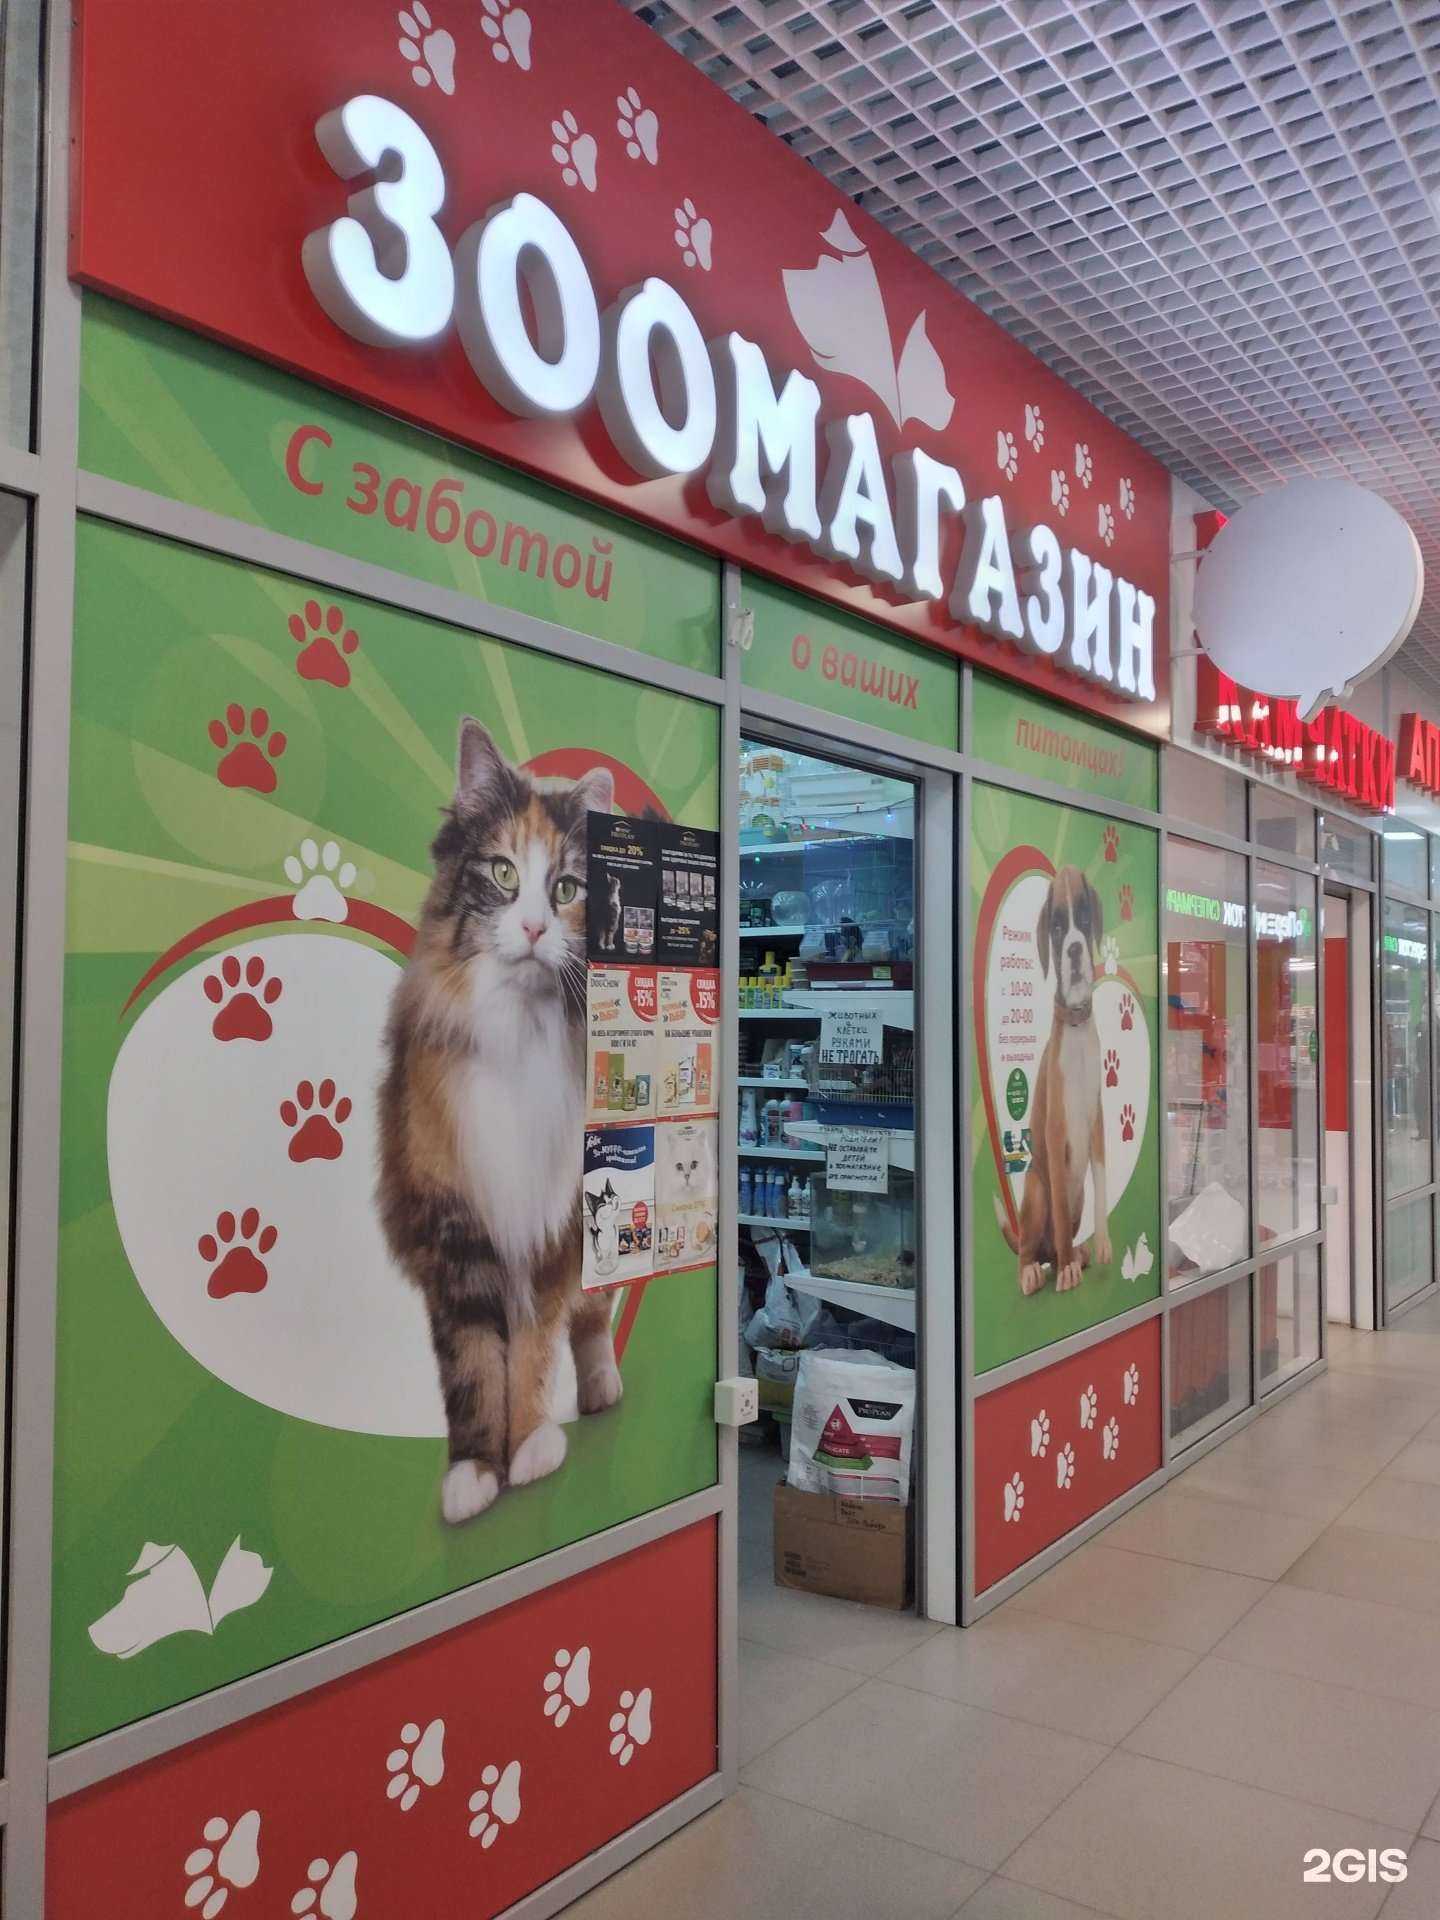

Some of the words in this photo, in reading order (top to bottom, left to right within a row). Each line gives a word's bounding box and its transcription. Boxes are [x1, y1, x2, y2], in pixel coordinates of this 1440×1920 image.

[305, 94, 1158, 702] ЗООМАГАЗИН
[285, 424, 333, 496] С
[346, 461, 614, 602] заботой
[820, 644, 920, 710] ваших
[1010, 981, 1034, 997] 10-00
[1010, 1008, 1034, 1024] 20-00
[821, 1049, 834, 1062] НЕ
[836, 1049, 880, 1064] ТРОГАТЬ
